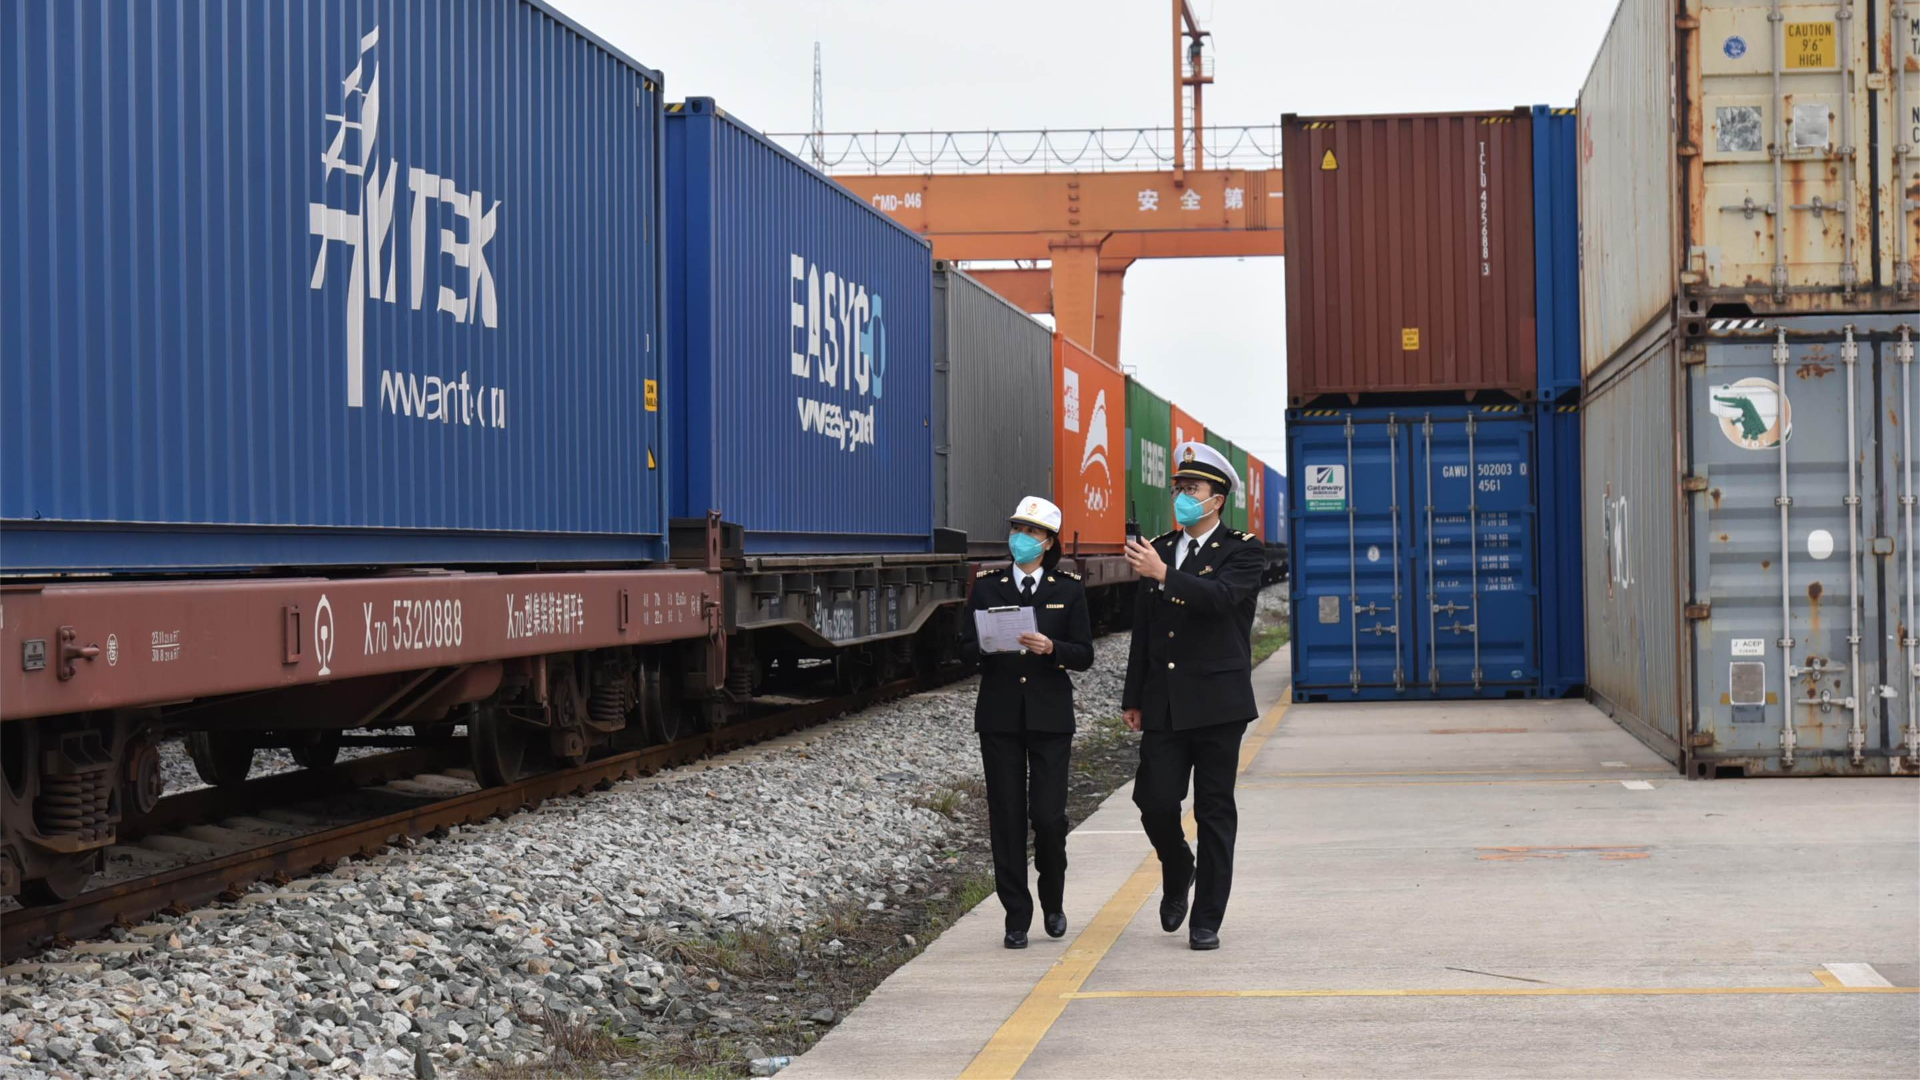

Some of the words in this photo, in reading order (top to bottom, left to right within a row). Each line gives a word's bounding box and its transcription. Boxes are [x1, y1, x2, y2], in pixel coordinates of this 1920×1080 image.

[1788, 24, 1831, 37] CAUTION
[1799, 54, 1822, 66] HIGH
[1480, 189, 1489, 260] 495688
[1482, 263, 1490, 276] 3
[1442, 465, 1468, 478] GAWU
[1478, 463, 1513, 477] 502003
[1306, 484, 1344, 492] Gateway
[1478, 479, 1501, 492] 45G1
[393, 598, 463, 651] 5320888
